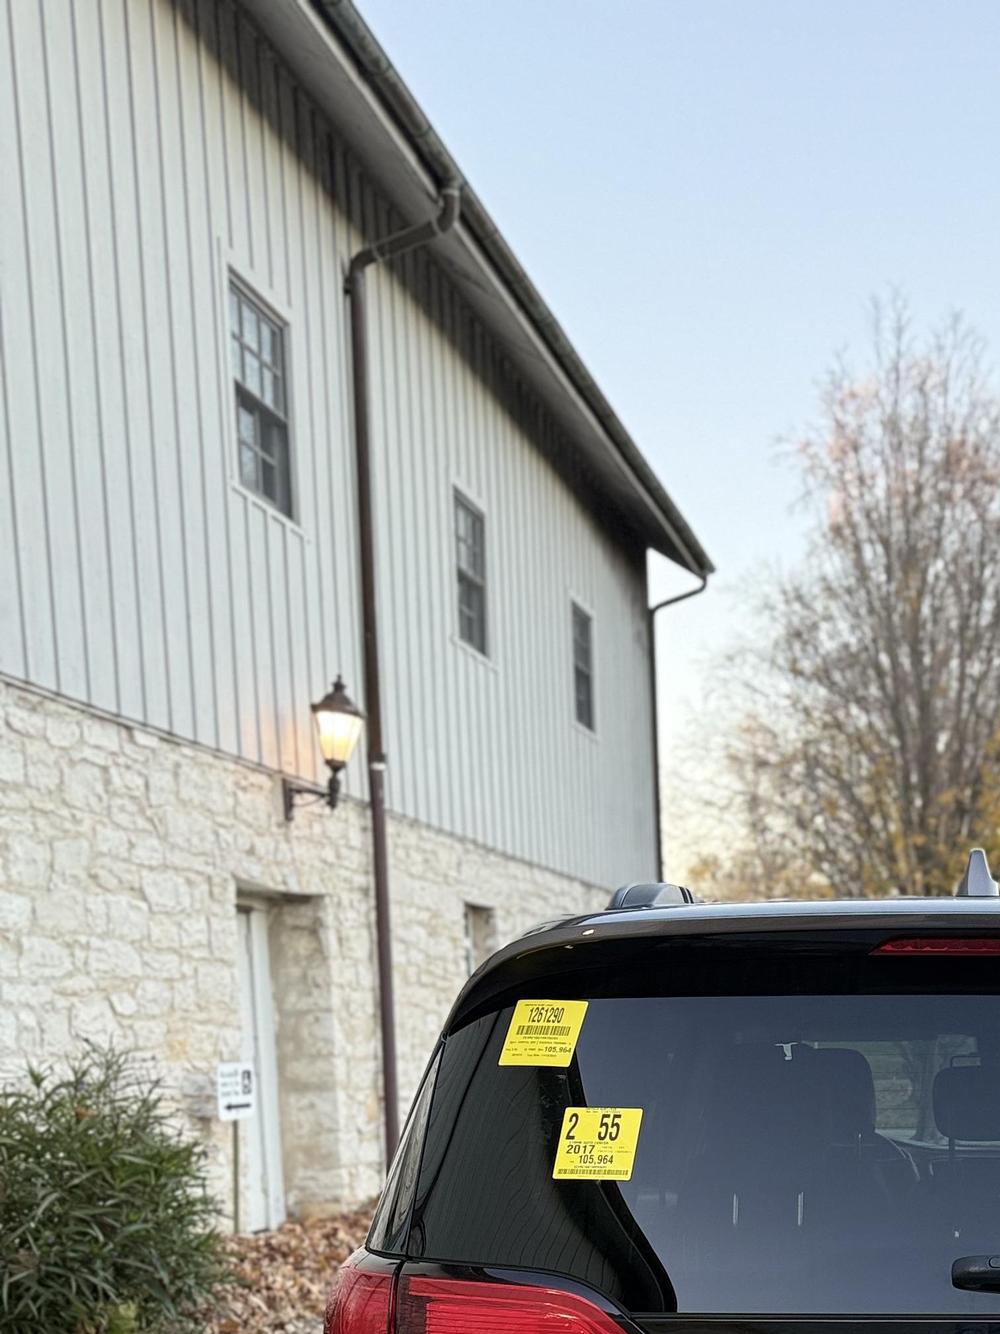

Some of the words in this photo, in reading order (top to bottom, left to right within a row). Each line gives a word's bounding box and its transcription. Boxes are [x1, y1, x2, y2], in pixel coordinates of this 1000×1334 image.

[527, 1007, 565, 1023] 1261290
[544, 1046, 572, 1054] 105,964
[565, 1113, 579, 1140] 2
[597, 1113, 622, 1141] 55
[566, 1144, 596, 1154] 2017
[579, 1154, 614, 1165] 105,964
